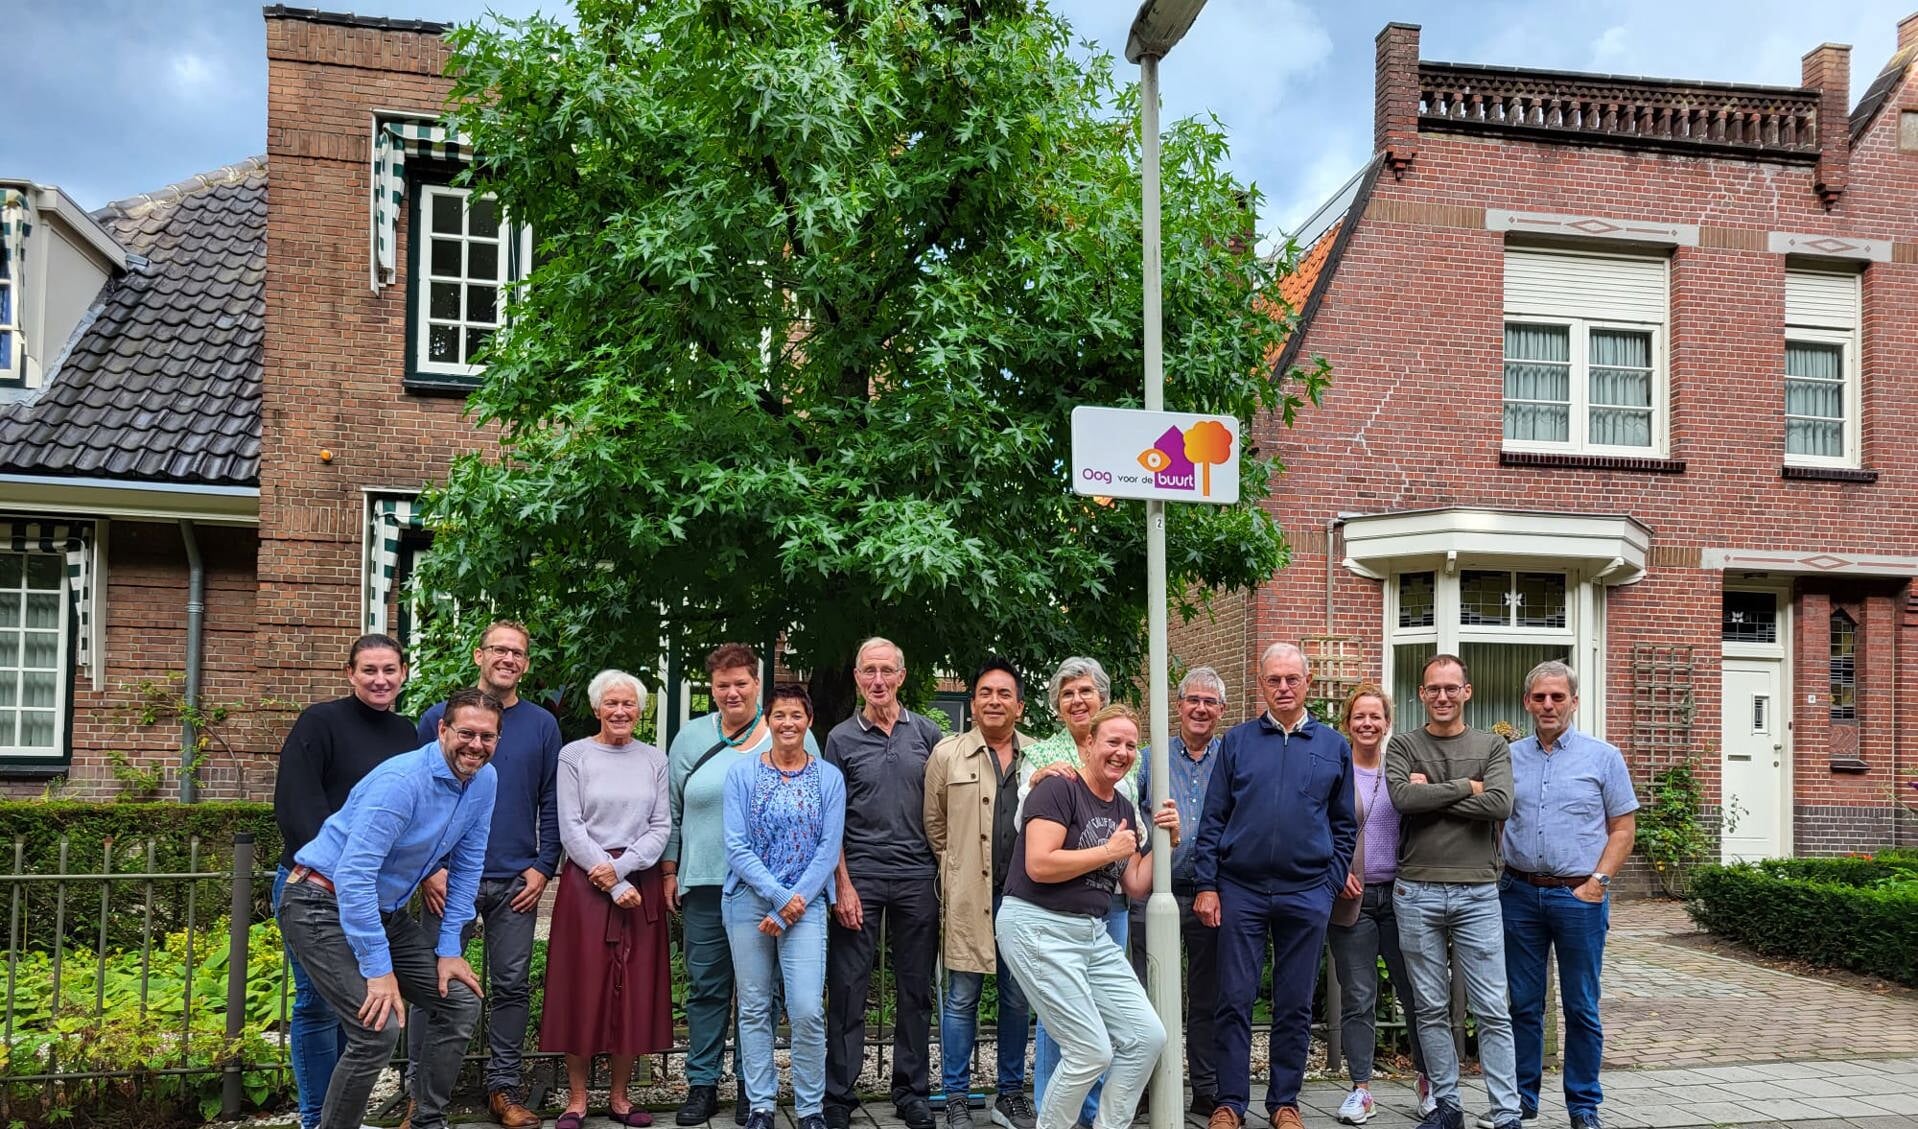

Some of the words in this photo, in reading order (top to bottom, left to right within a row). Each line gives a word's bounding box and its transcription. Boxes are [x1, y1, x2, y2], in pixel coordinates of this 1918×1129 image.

[1082, 468, 1112, 484] Oog
[1117, 475, 1138, 483] voor
[1141, 476, 1153, 484] de
[1158, 473, 1194, 487] buurt
